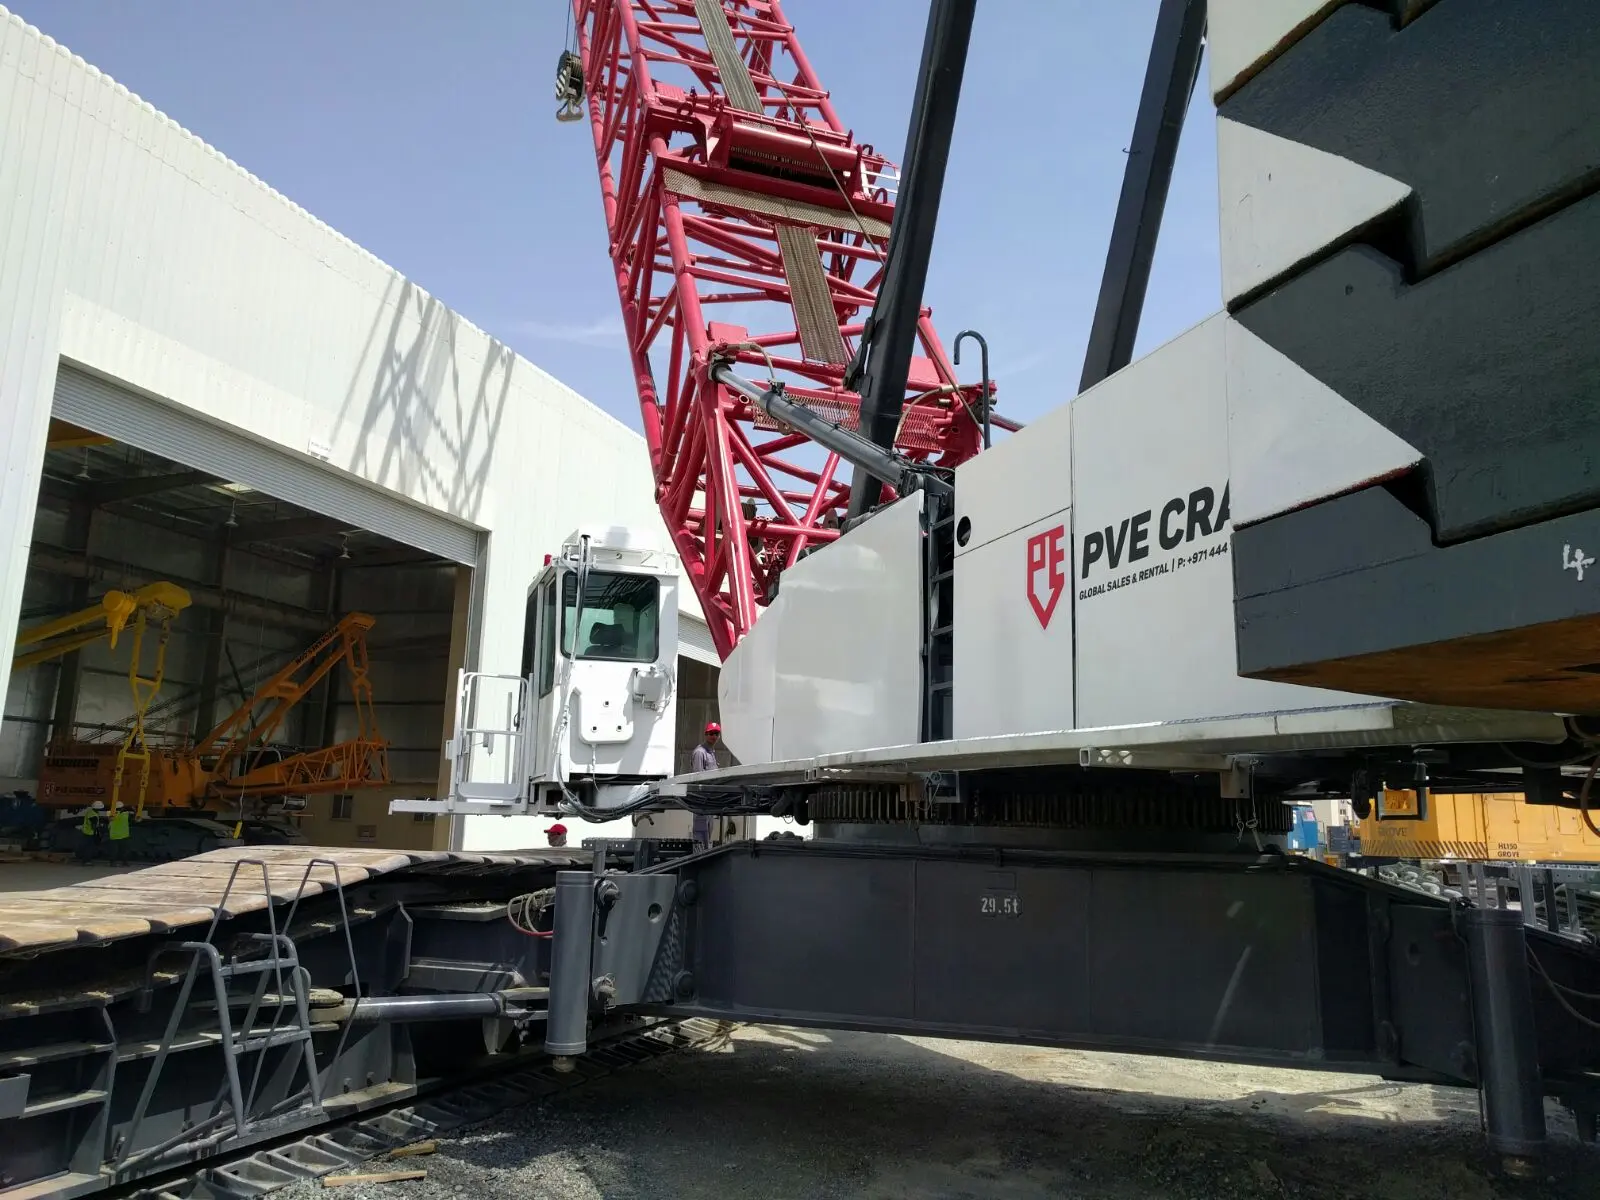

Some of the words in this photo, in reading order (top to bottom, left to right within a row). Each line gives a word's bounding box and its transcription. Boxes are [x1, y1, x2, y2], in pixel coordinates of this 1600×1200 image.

[1082, 509, 1152, 580] PVE
[1562, 543, 1596, 581] 4
[1079, 583, 1106, 601] GLOBAL
[1107, 575, 1131, 592] SALES
[1131, 572, 1138, 584] &
[1138, 562, 1169, 581] RENTAL
[1187, 548, 1208, 565] +971
[1497, 850, 1520, 858] GROVE
[981, 897, 1019, 914] 29.5t
